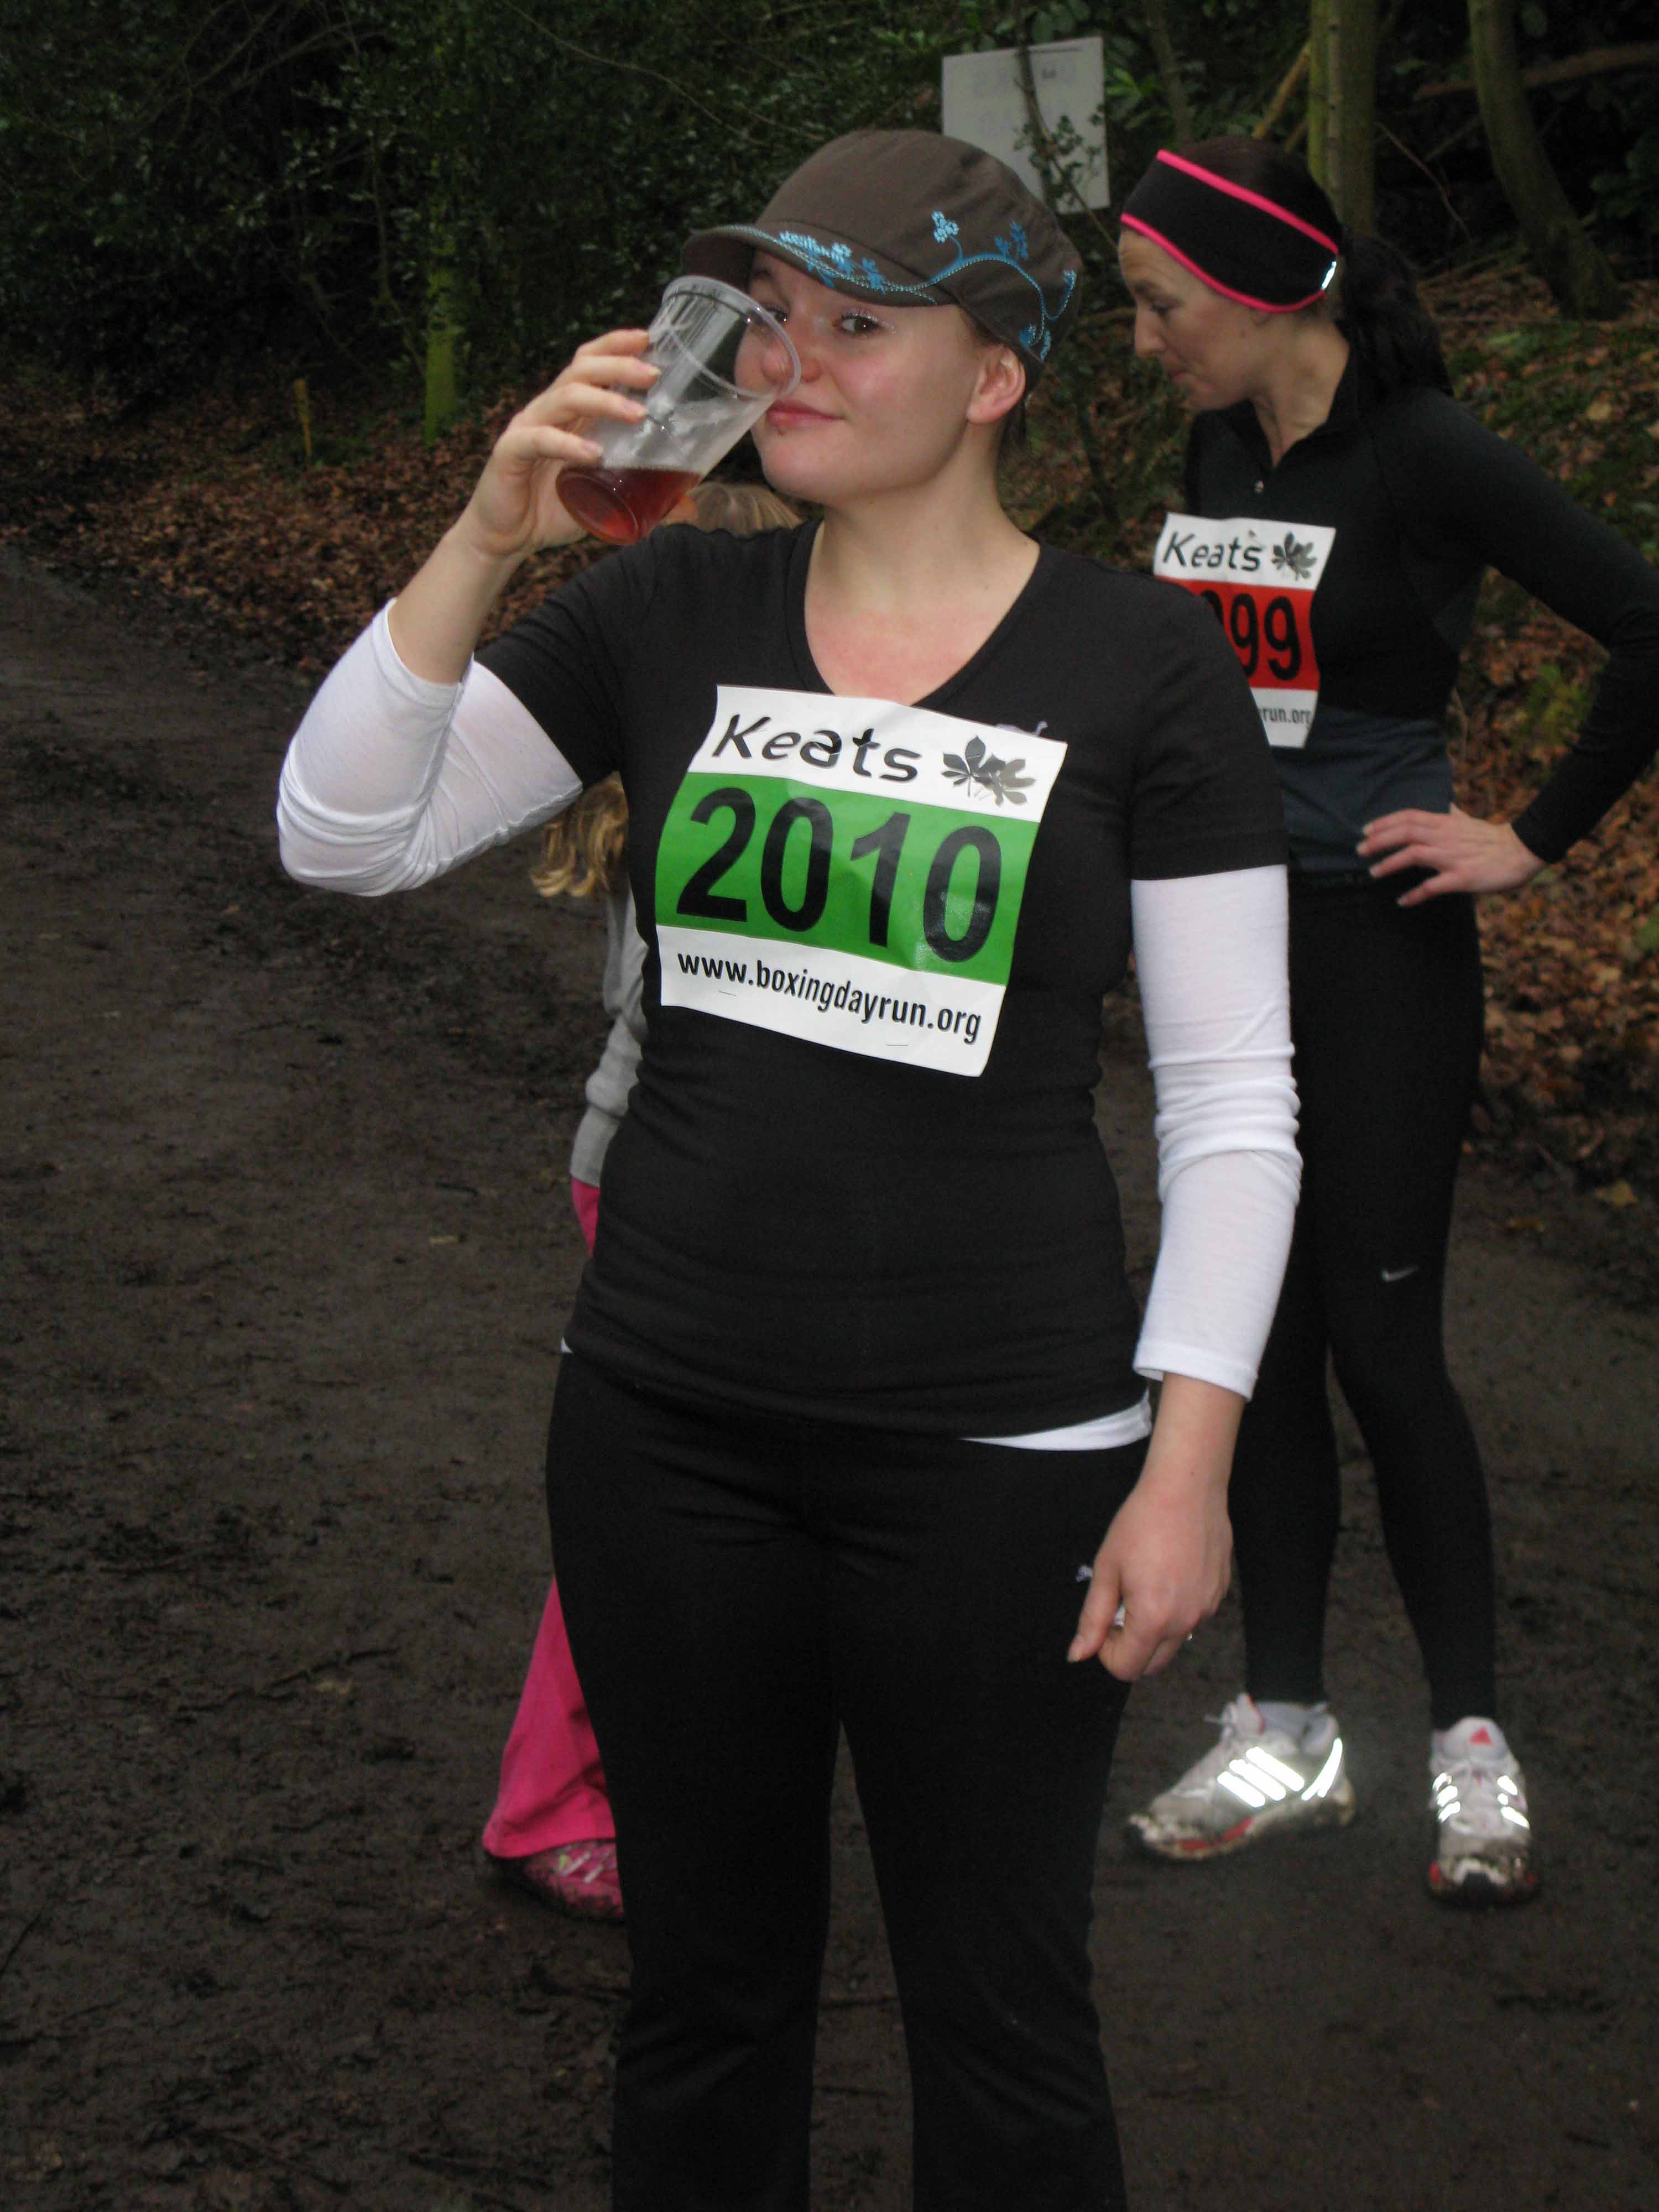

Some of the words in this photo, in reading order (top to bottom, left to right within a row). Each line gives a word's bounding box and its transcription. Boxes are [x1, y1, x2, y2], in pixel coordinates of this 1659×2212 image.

[1163, 530, 1263, 571] Keats
[1201, 590, 1301, 680] 99
[712, 714, 922, 782] Keats
[676, 787, 1002, 963] 2010
[677, 953, 982, 1044] www.boxingdayrun.org
